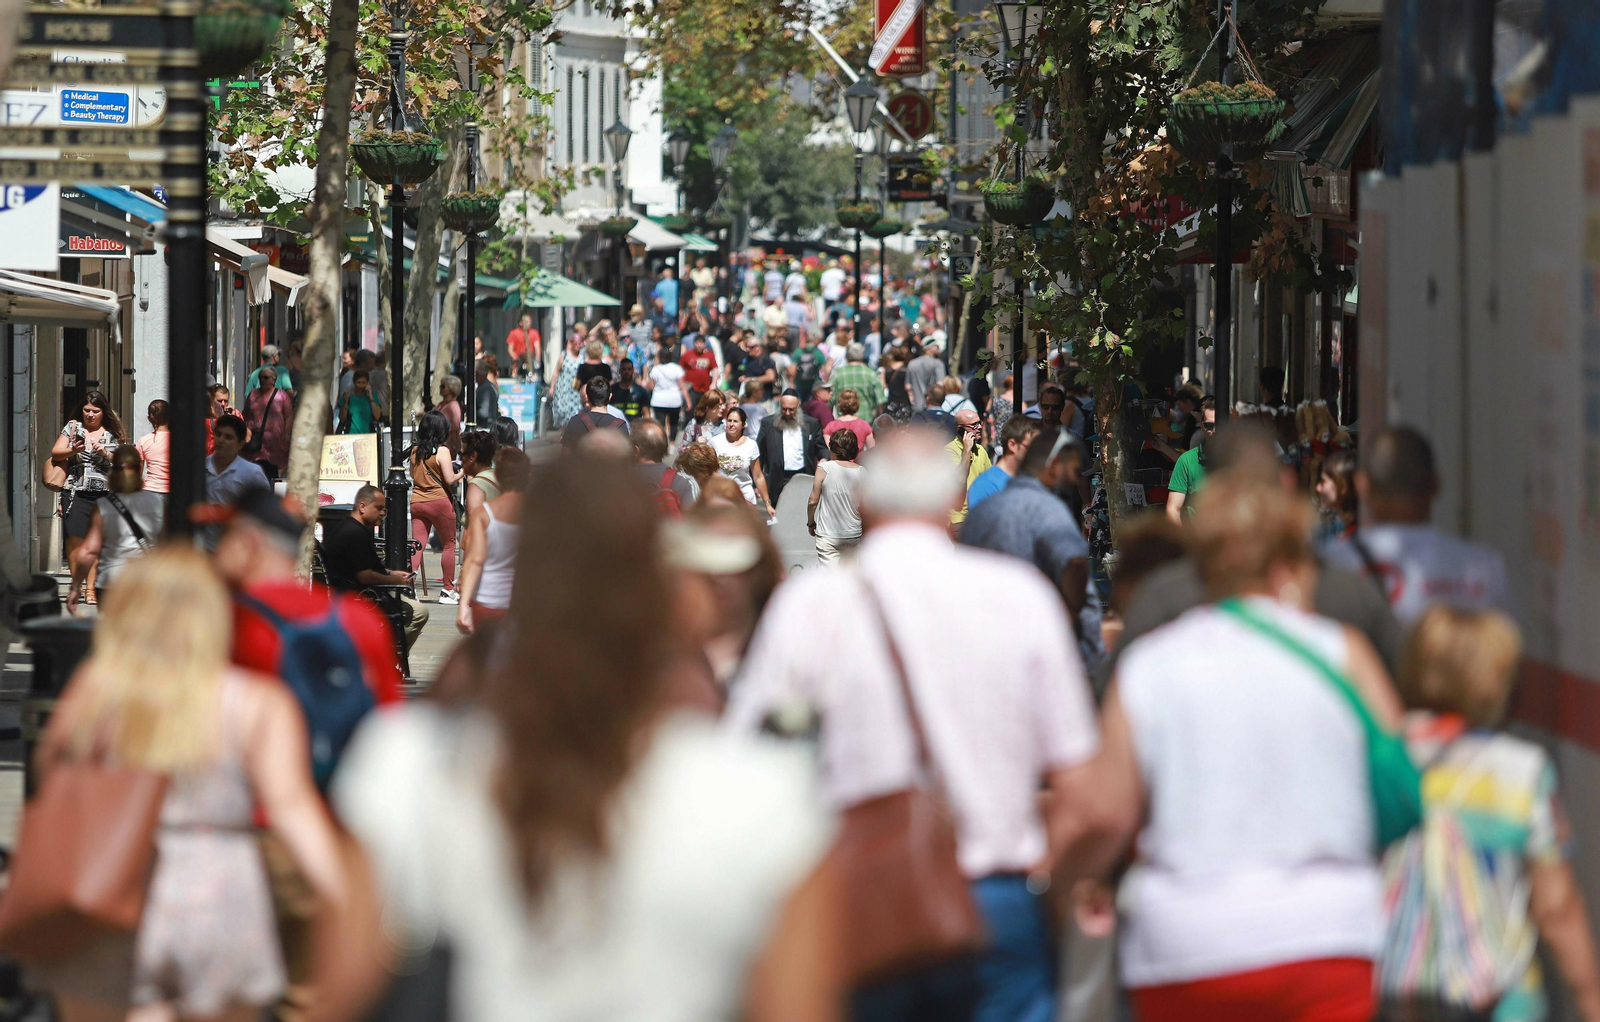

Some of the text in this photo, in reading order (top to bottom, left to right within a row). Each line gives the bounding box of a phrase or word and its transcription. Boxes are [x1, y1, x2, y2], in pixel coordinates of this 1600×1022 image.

[894, 46, 921, 54] WINES
[897, 55, 917, 63] AND
[70, 92, 99, 101] Medical
[70, 101, 126, 112] Complementary
[70, 110, 125, 122] Beauty Therapy
[68, 236, 124, 250] Habanos
